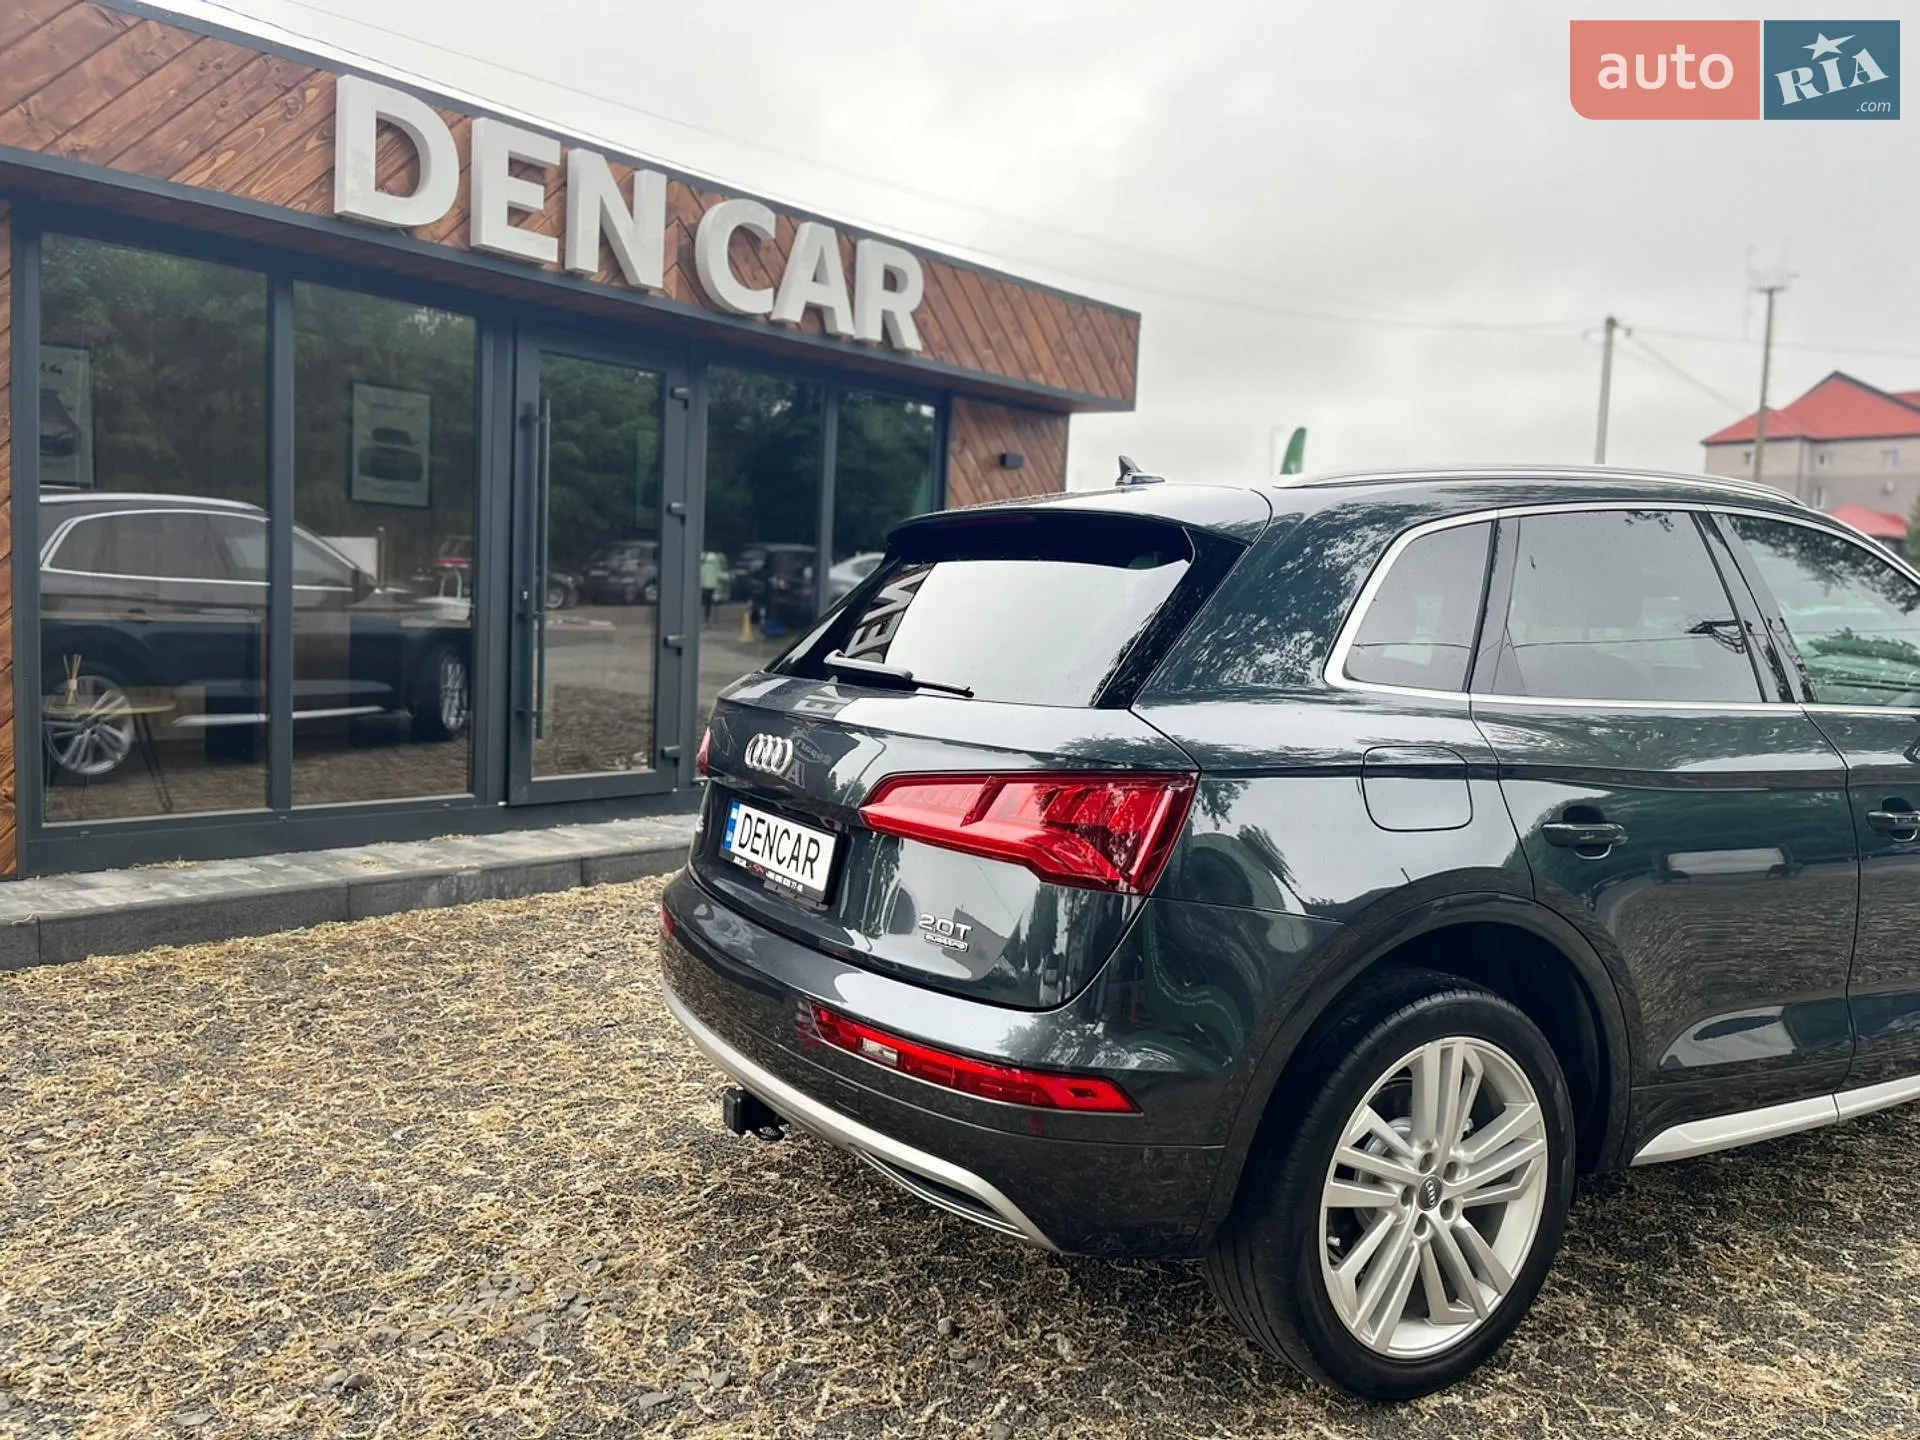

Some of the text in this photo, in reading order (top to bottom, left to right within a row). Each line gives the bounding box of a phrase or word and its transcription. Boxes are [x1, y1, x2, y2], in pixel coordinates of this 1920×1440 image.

[333, 74, 925, 352] DEN CAR
[738, 812, 821, 880] DENCAR
